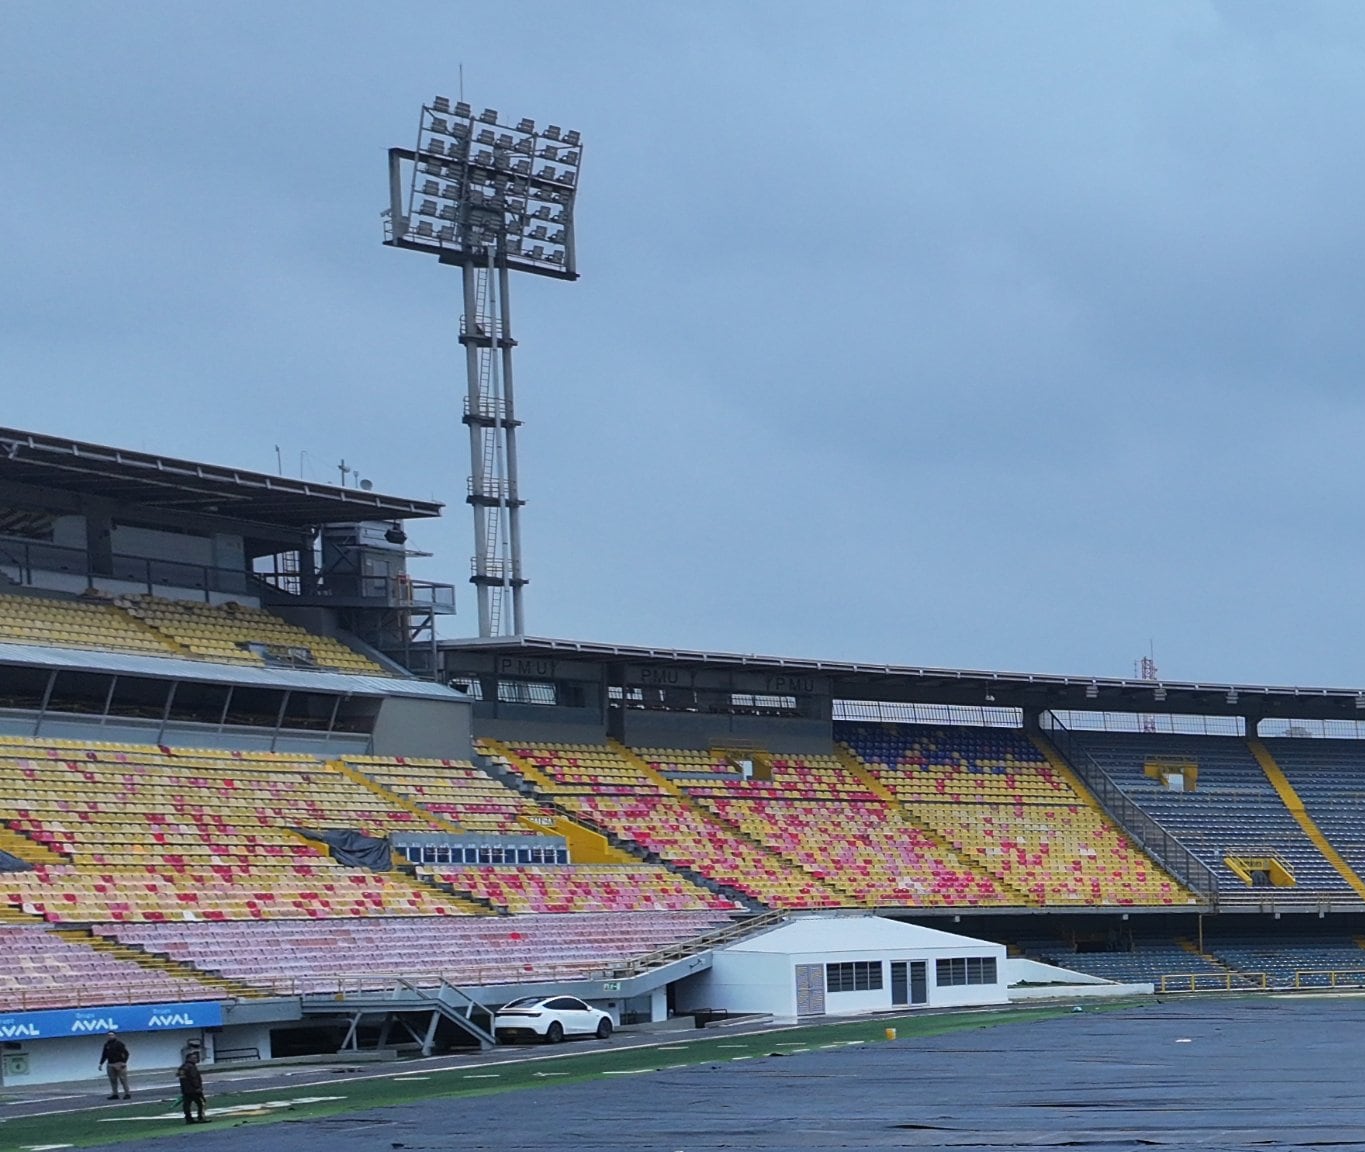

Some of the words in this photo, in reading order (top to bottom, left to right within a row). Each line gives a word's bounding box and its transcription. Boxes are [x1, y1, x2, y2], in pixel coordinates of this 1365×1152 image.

[501, 659, 547, 676] PMU
[640, 668, 678, 685] PMU
[775, 677, 814, 693] PMU
[72, 1018, 118, 1032] AVAL
[148, 1013, 194, 1027] AVAL
